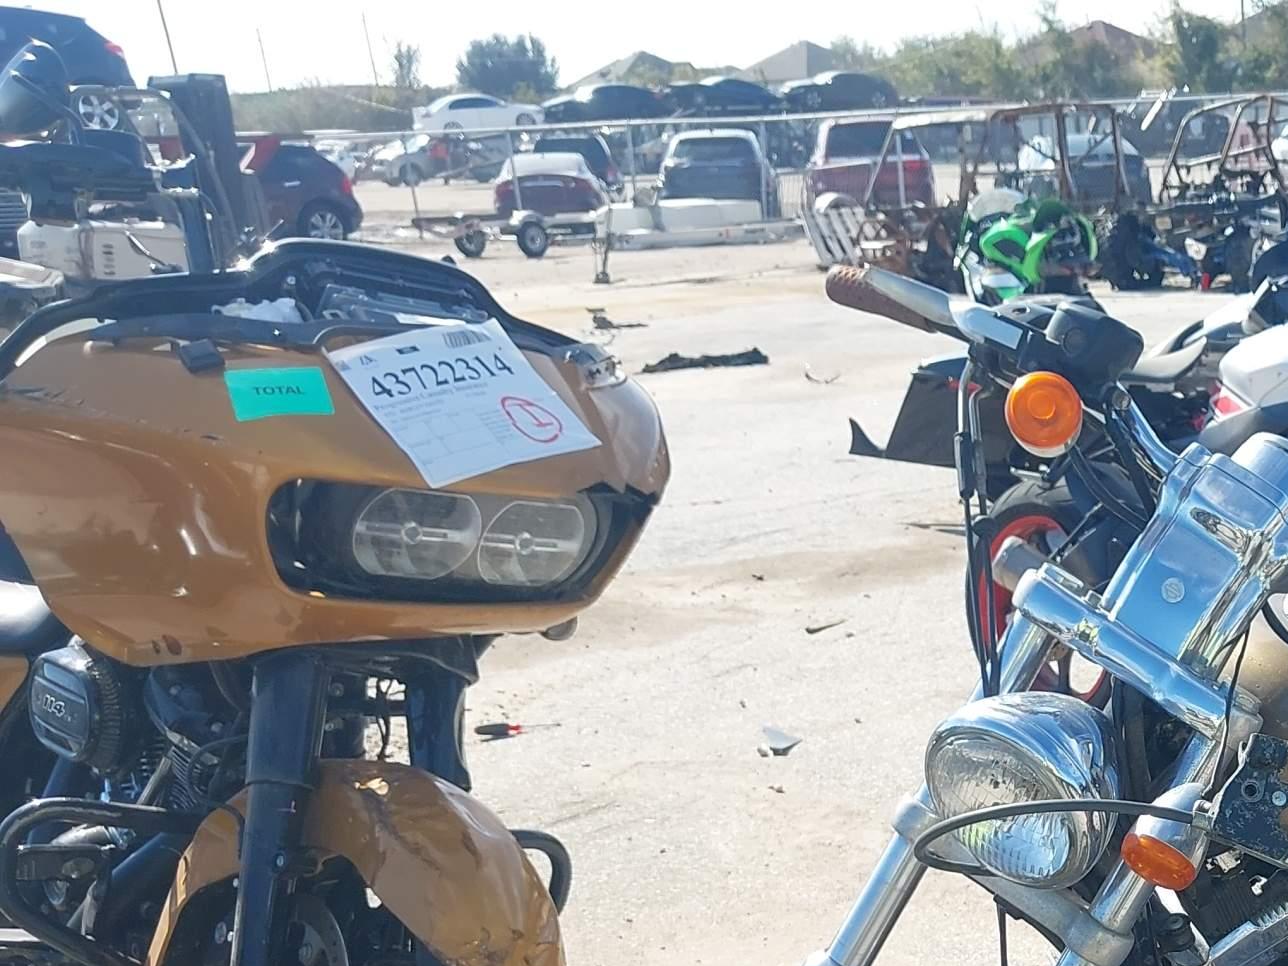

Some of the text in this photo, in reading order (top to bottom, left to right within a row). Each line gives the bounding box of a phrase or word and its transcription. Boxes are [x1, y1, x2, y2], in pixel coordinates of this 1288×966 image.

[371, 353, 515, 398] 43722314
[254, 385, 305, 396] TOTAL
[42, 693, 65, 717] 114
